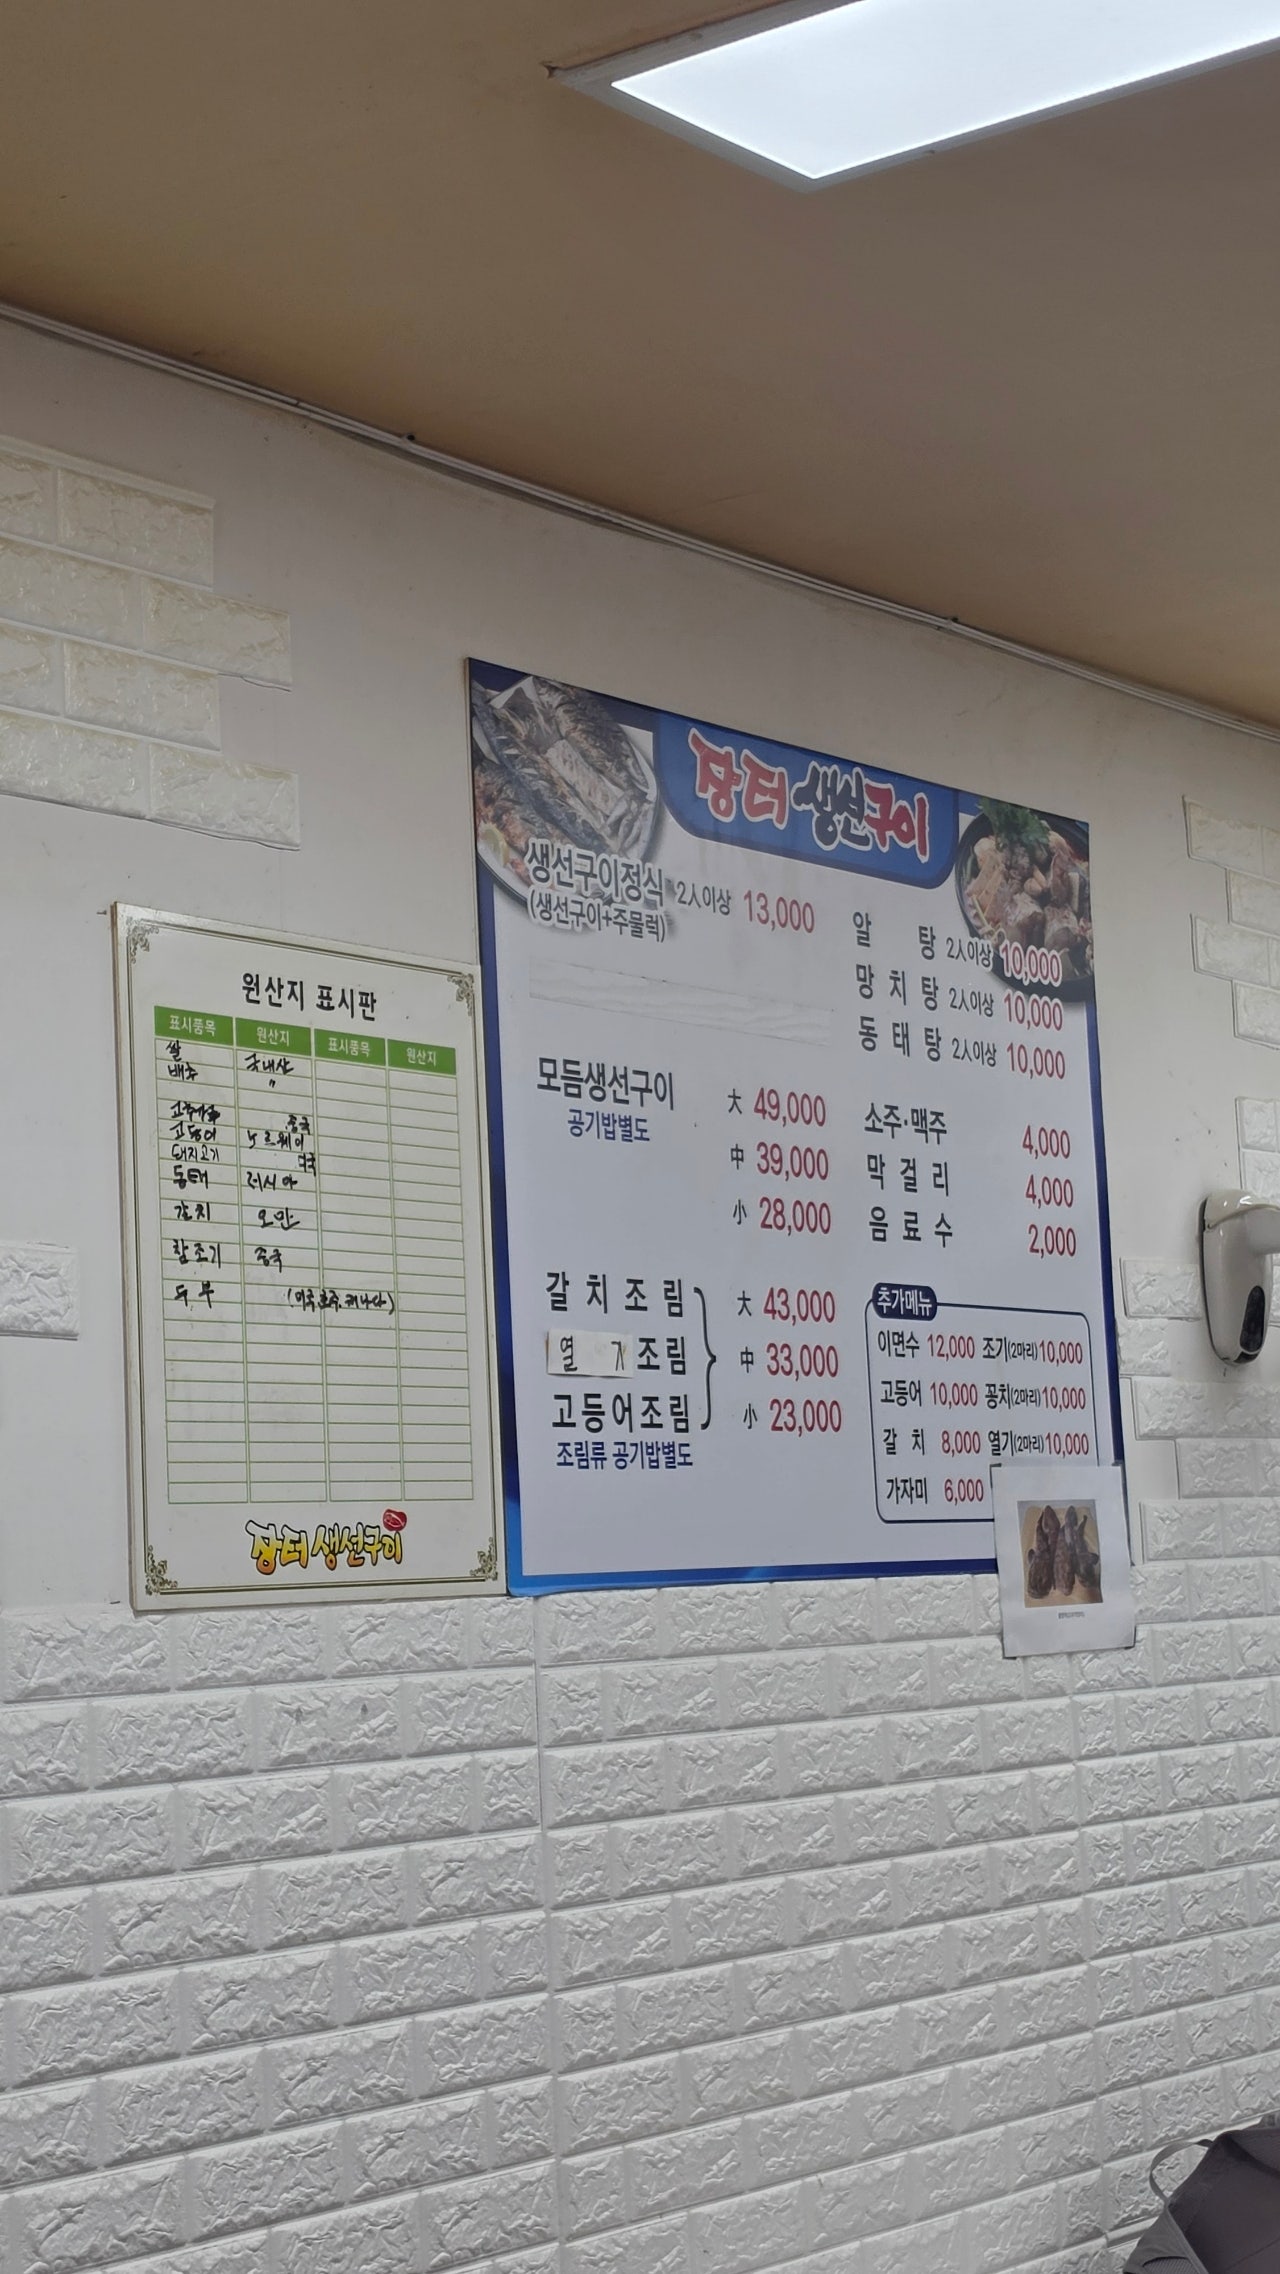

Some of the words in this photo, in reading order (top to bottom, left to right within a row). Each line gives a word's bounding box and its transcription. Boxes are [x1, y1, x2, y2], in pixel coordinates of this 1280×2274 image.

[688, 728, 789, 830] 장터
[790, 760, 929, 863] 생선구이
[527, 841, 664, 906] 생선구이정식
[743, 889, 815, 934] 13,000
[528, 889, 667, 942] (생선구이+주물럭)
[1001, 942, 1062, 986] 10,000
[242, 973, 304, 1011] 원산지
[316, 984, 377, 1022] 표시판
[1003, 992, 1064, 1032] 10,000
[169, 1014, 217, 1037] 표시품목
[256, 1026, 290, 1047] 원산지
[166, 1040, 182, 1062] 쌀
[244, 1052, 294, 1075] 국내산
[327, 1037, 371, 1058] 표시품목
[406, 1047, 437, 1067] 원산지
[1006, 1042, 1066, 1080] 10,000
[167, 1062, 198, 1081] 배추
[536, 1056, 675, 1111] 모듬생선구이
[728, 1088, 743, 1115] 大
[753, 1087, 826, 1128] 49,000
[567, 1108, 651, 1143] 공기밥별도
[1022, 1125, 1071, 1160] 4,000
[173, 1164, 209, 1189] 동태
[730, 1143, 745, 1170] 中
[756, 1141, 829, 1182] 39,000
[1025, 1174, 1074, 1209] 4,000
[174, 1200, 211, 1221] 갈치
[732, 1199, 748, 1226] 小
[759, 1196, 832, 1236] 28,000
[1028, 1224, 1077, 1259] 2,000
[737, 1290, 753, 1317] 大
[762, 1287, 836, 1327] 43,000
[877, 1287, 933, 1317] 추가메뉴
[740, 1346, 755, 1374] 中
[766, 1342, 839, 1382] 33,000
[877, 1329, 921, 1359] 이면수
[927, 1333, 976, 1362] 12,000
[1039, 1339, 1083, 1367] 10,000
[551, 1392, 690, 1434] 고등어조림
[880, 1379, 923, 1408] 고등어
[930, 1381, 978, 1410] 10,000
[1042, 1386, 1087, 1413] 10,000
[743, 1403, 758, 1430] 小
[769, 1398, 843, 1438] 23,000
[556, 1440, 608, 1471] 조림류
[612, 1440, 694, 1471] 공기밥별도
[941, 1430, 981, 1458] 8,000
[1044, 1432, 1090, 1459] 10,000
[886, 1477, 928, 1505] 가자미
[944, 1478, 984, 1506] 6,000
[245, 1519, 309, 1576] 장터
[311, 1521, 403, 1571] 생선구이
